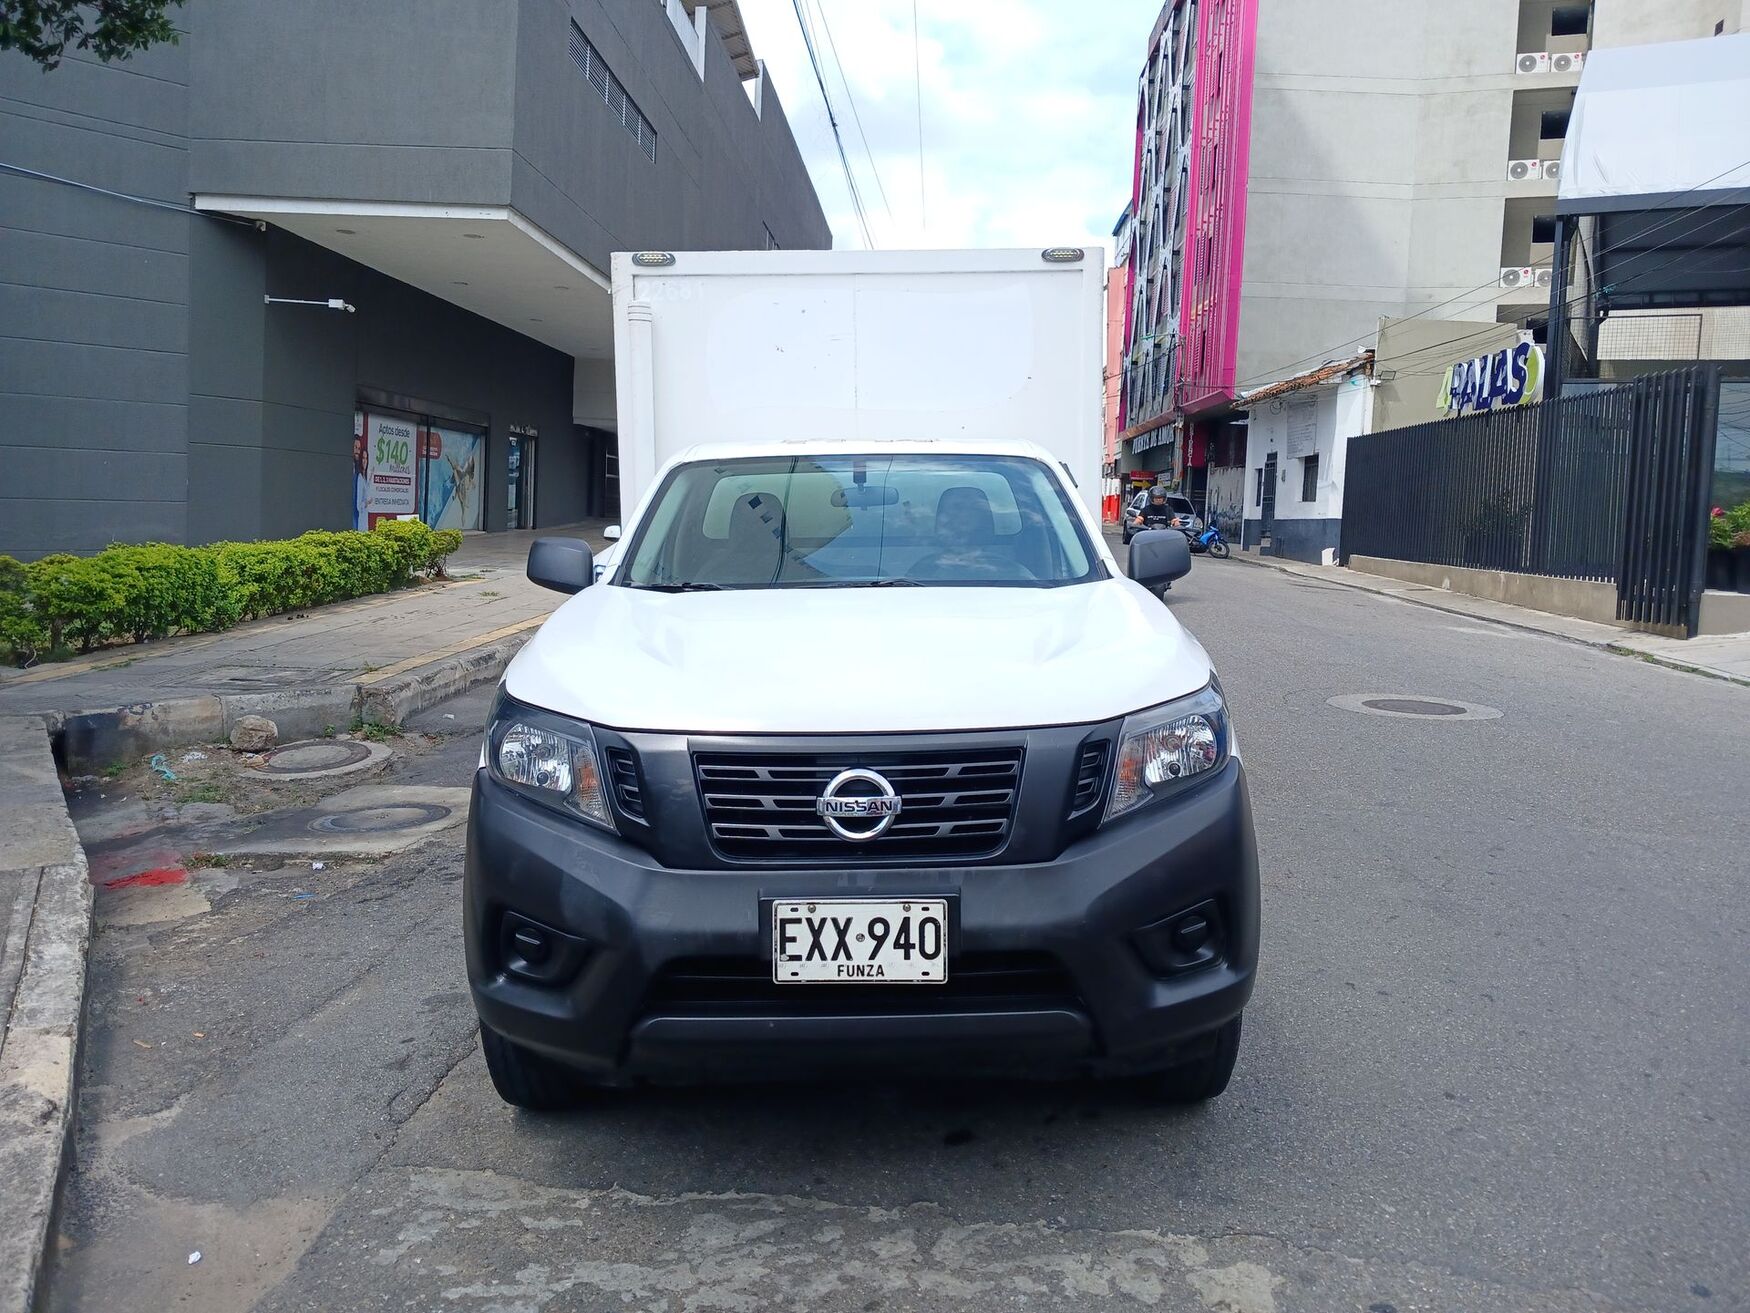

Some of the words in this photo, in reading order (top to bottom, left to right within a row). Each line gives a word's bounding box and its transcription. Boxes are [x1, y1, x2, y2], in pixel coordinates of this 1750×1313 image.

[379, 424, 394, 438] Aptos
[395, 427, 410, 438] desde
[376, 437, 408, 465] $140
[826, 801, 892, 812] NISSAN
[837, 964, 884, 977] FUNZA
